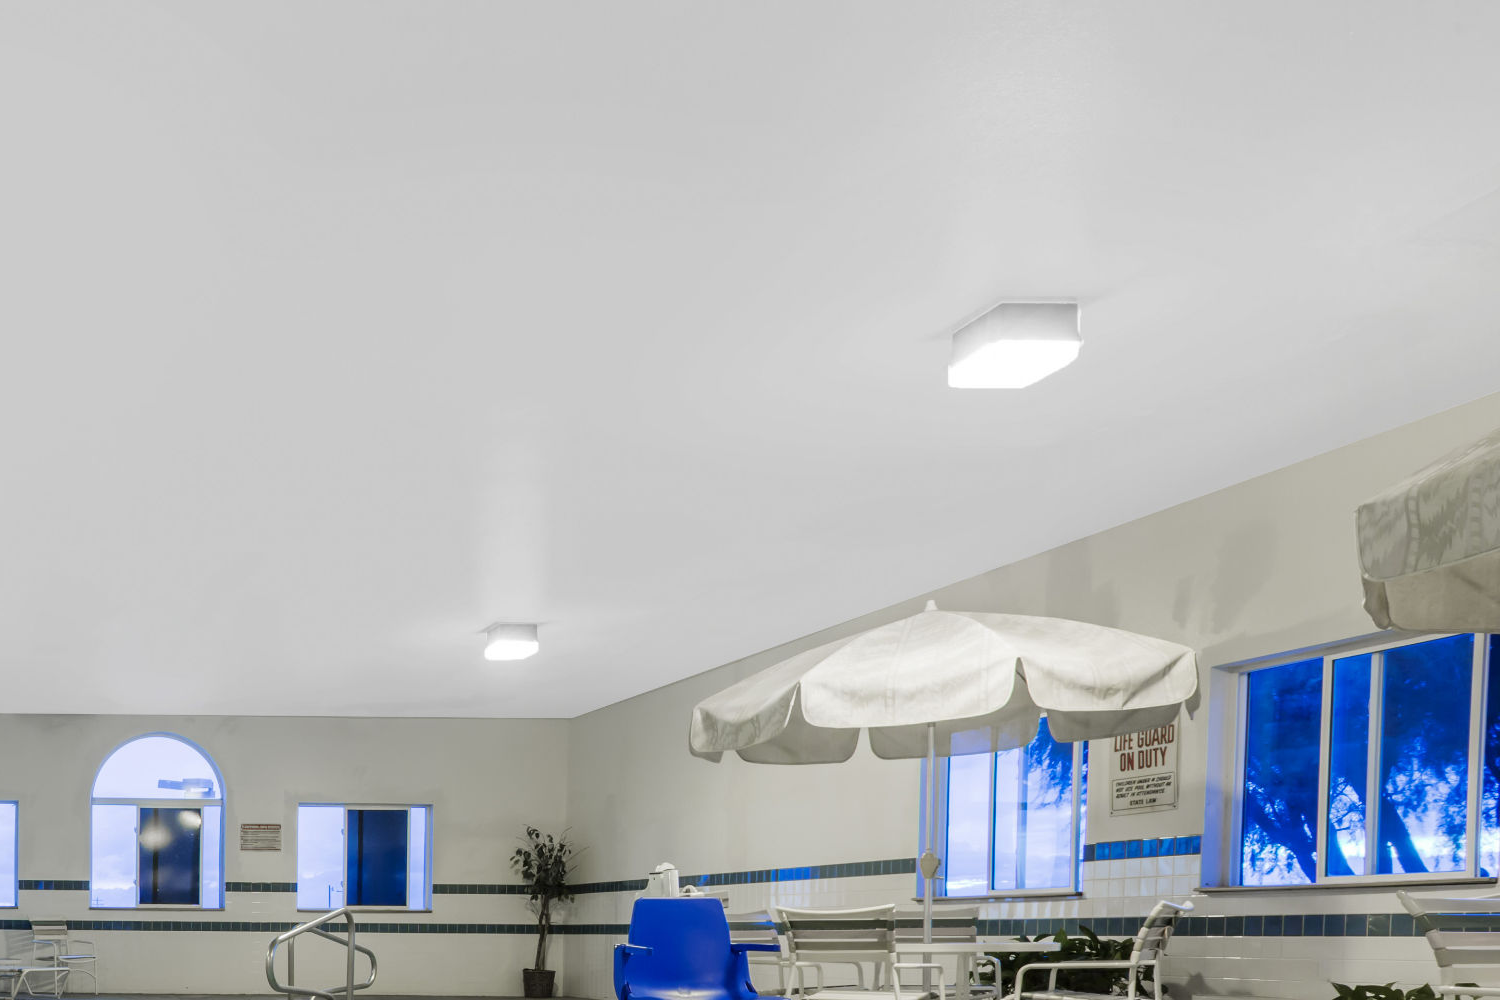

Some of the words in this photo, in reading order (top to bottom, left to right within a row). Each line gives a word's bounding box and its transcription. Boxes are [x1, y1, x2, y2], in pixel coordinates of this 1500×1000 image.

[1114, 733, 1133, 752] LIFE
[1138, 724, 1174, 748] GUARD
[1120, 752, 1134, 772] ON
[1138, 746, 1167, 770] DUTY
